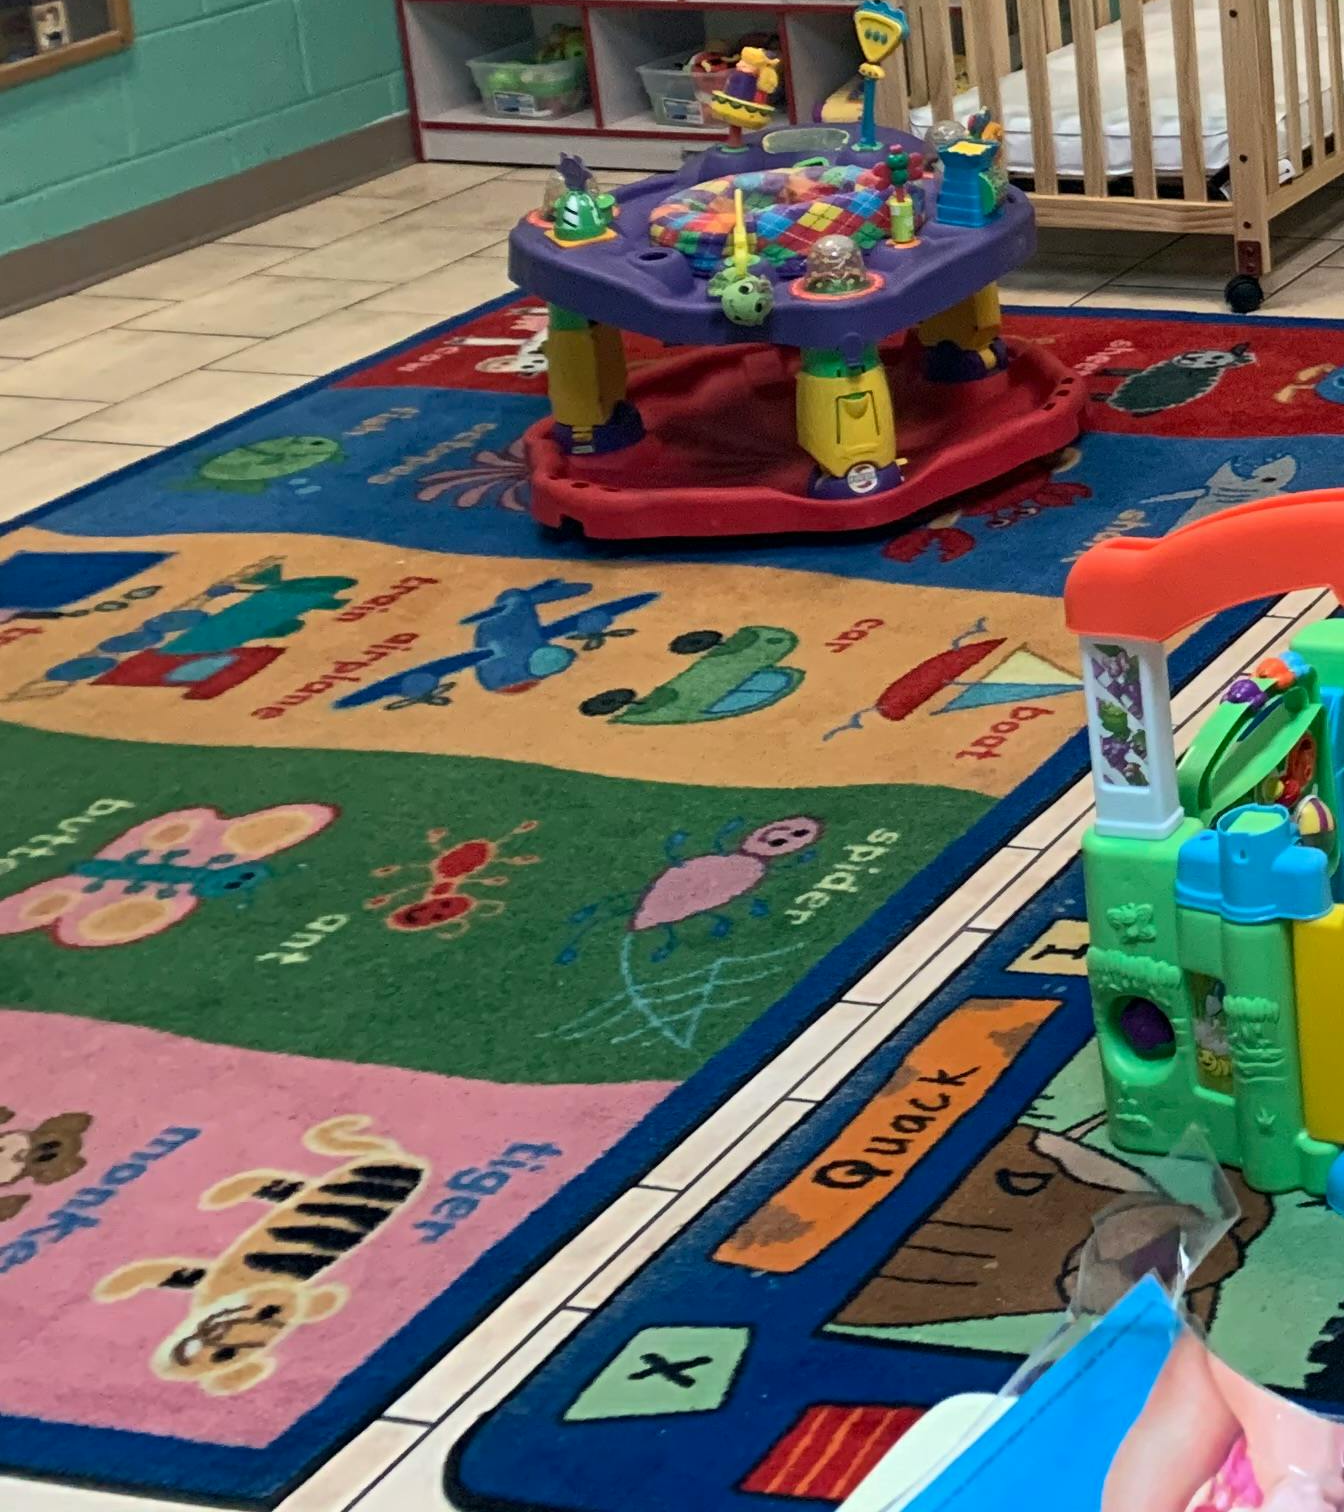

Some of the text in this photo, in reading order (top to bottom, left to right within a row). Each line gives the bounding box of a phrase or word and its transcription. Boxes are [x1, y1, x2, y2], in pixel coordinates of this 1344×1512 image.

[333, 576, 441, 622] train
[825, 618, 885, 653] car
[250, 632, 420, 720] airplane
[955, 705, 1056, 760] boat
[784, 827, 900, 926] spider
[255, 913, 348, 965] ant
[812, 1064, 982, 1190] Quack
[412, 1140, 563, 1245] tiger
